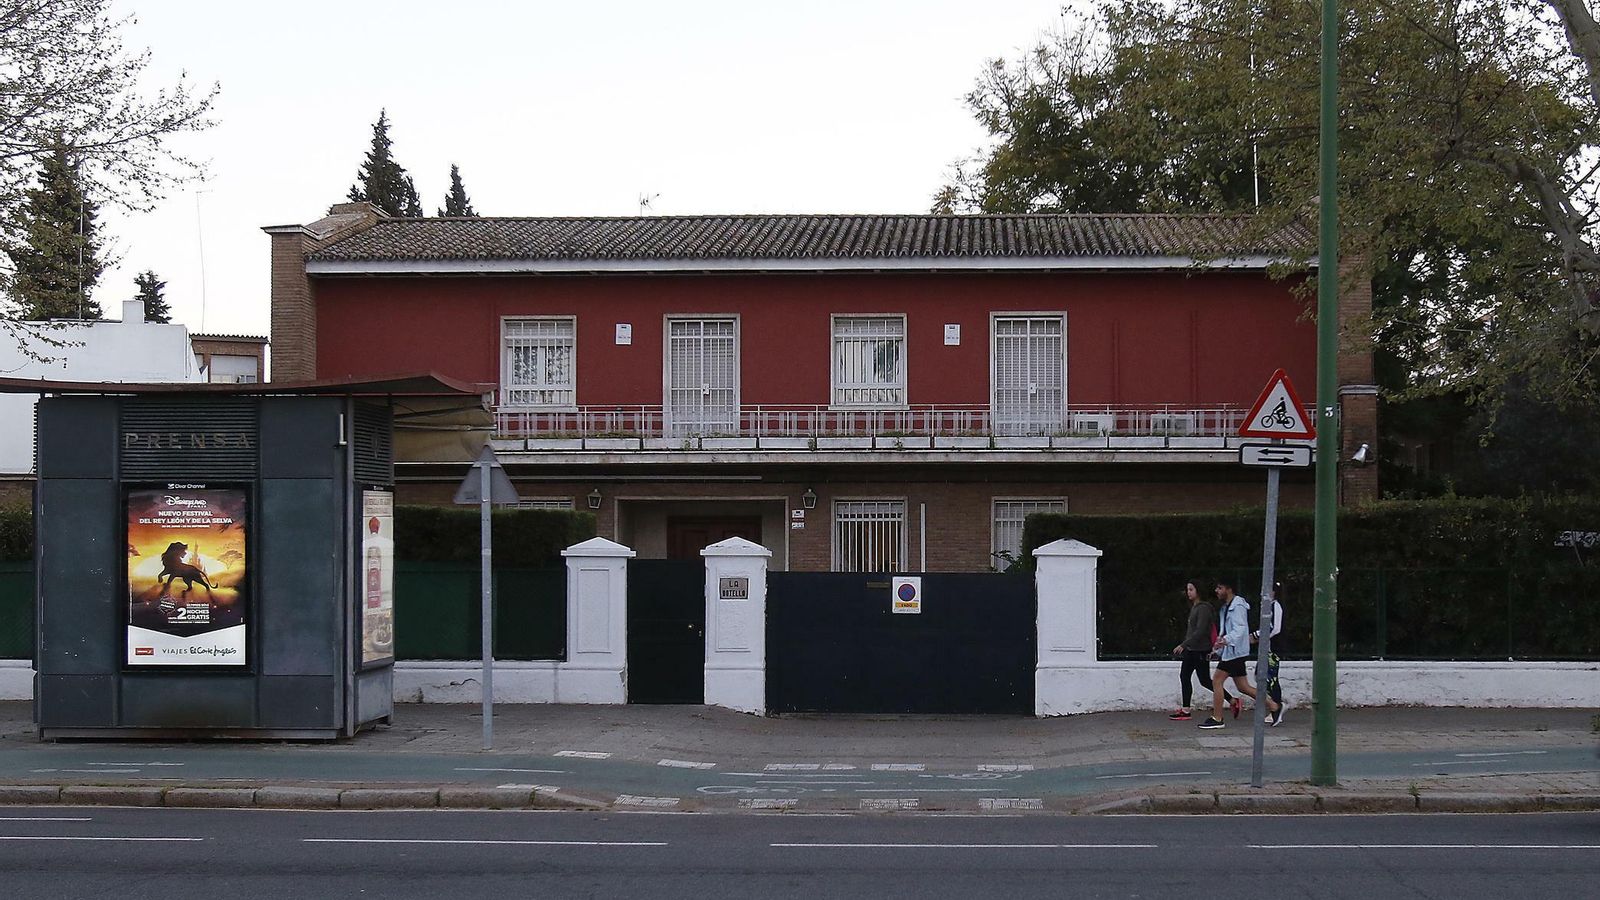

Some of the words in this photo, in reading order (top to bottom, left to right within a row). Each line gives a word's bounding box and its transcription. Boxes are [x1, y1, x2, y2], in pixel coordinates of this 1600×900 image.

[125, 432, 251, 449] PRENSA
[728, 580, 739, 588] LA
[177, 607, 187, 620] 2
